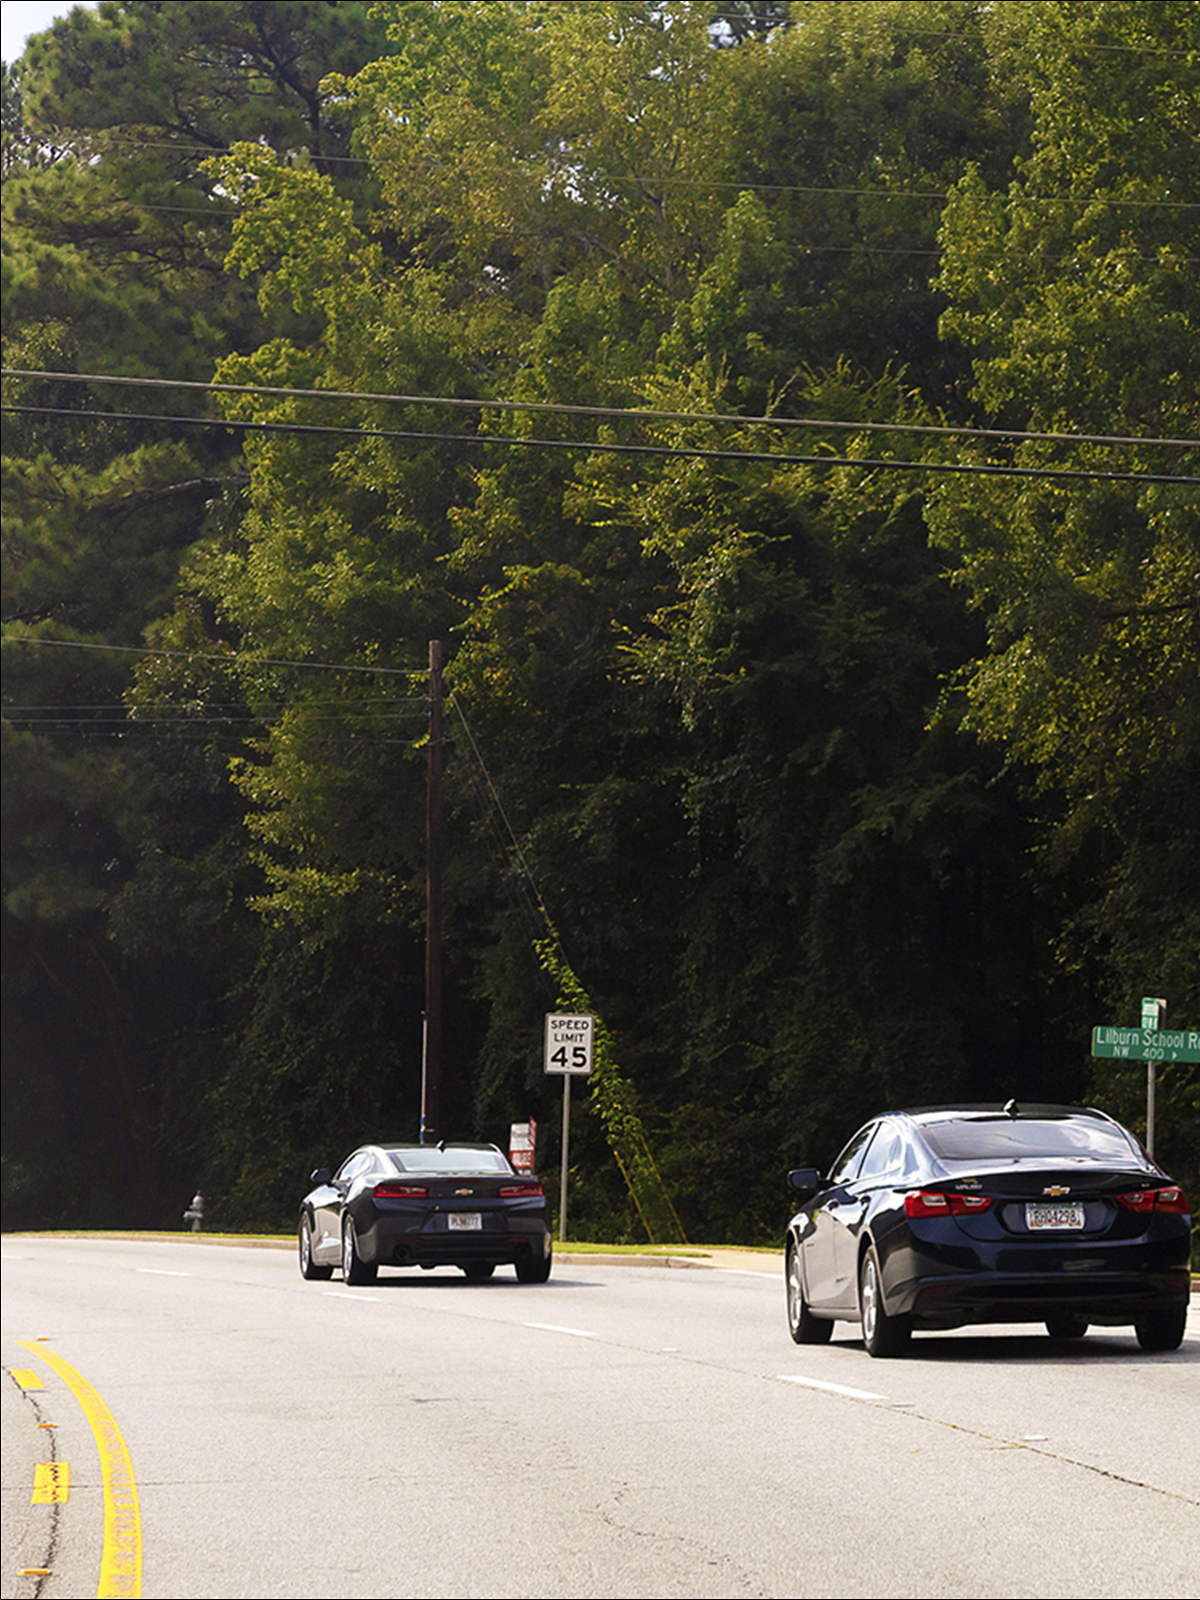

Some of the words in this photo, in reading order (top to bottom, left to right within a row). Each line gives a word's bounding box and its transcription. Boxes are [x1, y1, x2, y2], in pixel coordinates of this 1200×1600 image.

[551, 1019, 589, 1030] SPEED
[554, 1033, 584, 1043] LIMIT
[1096, 1027, 1139, 1046] Lilburn
[1142, 1029, 1184, 1048] School
[551, 1046, 587, 1068] 45
[1113, 1046, 1130, 1057] NW
[1142, 1048, 1165, 1060] 400
